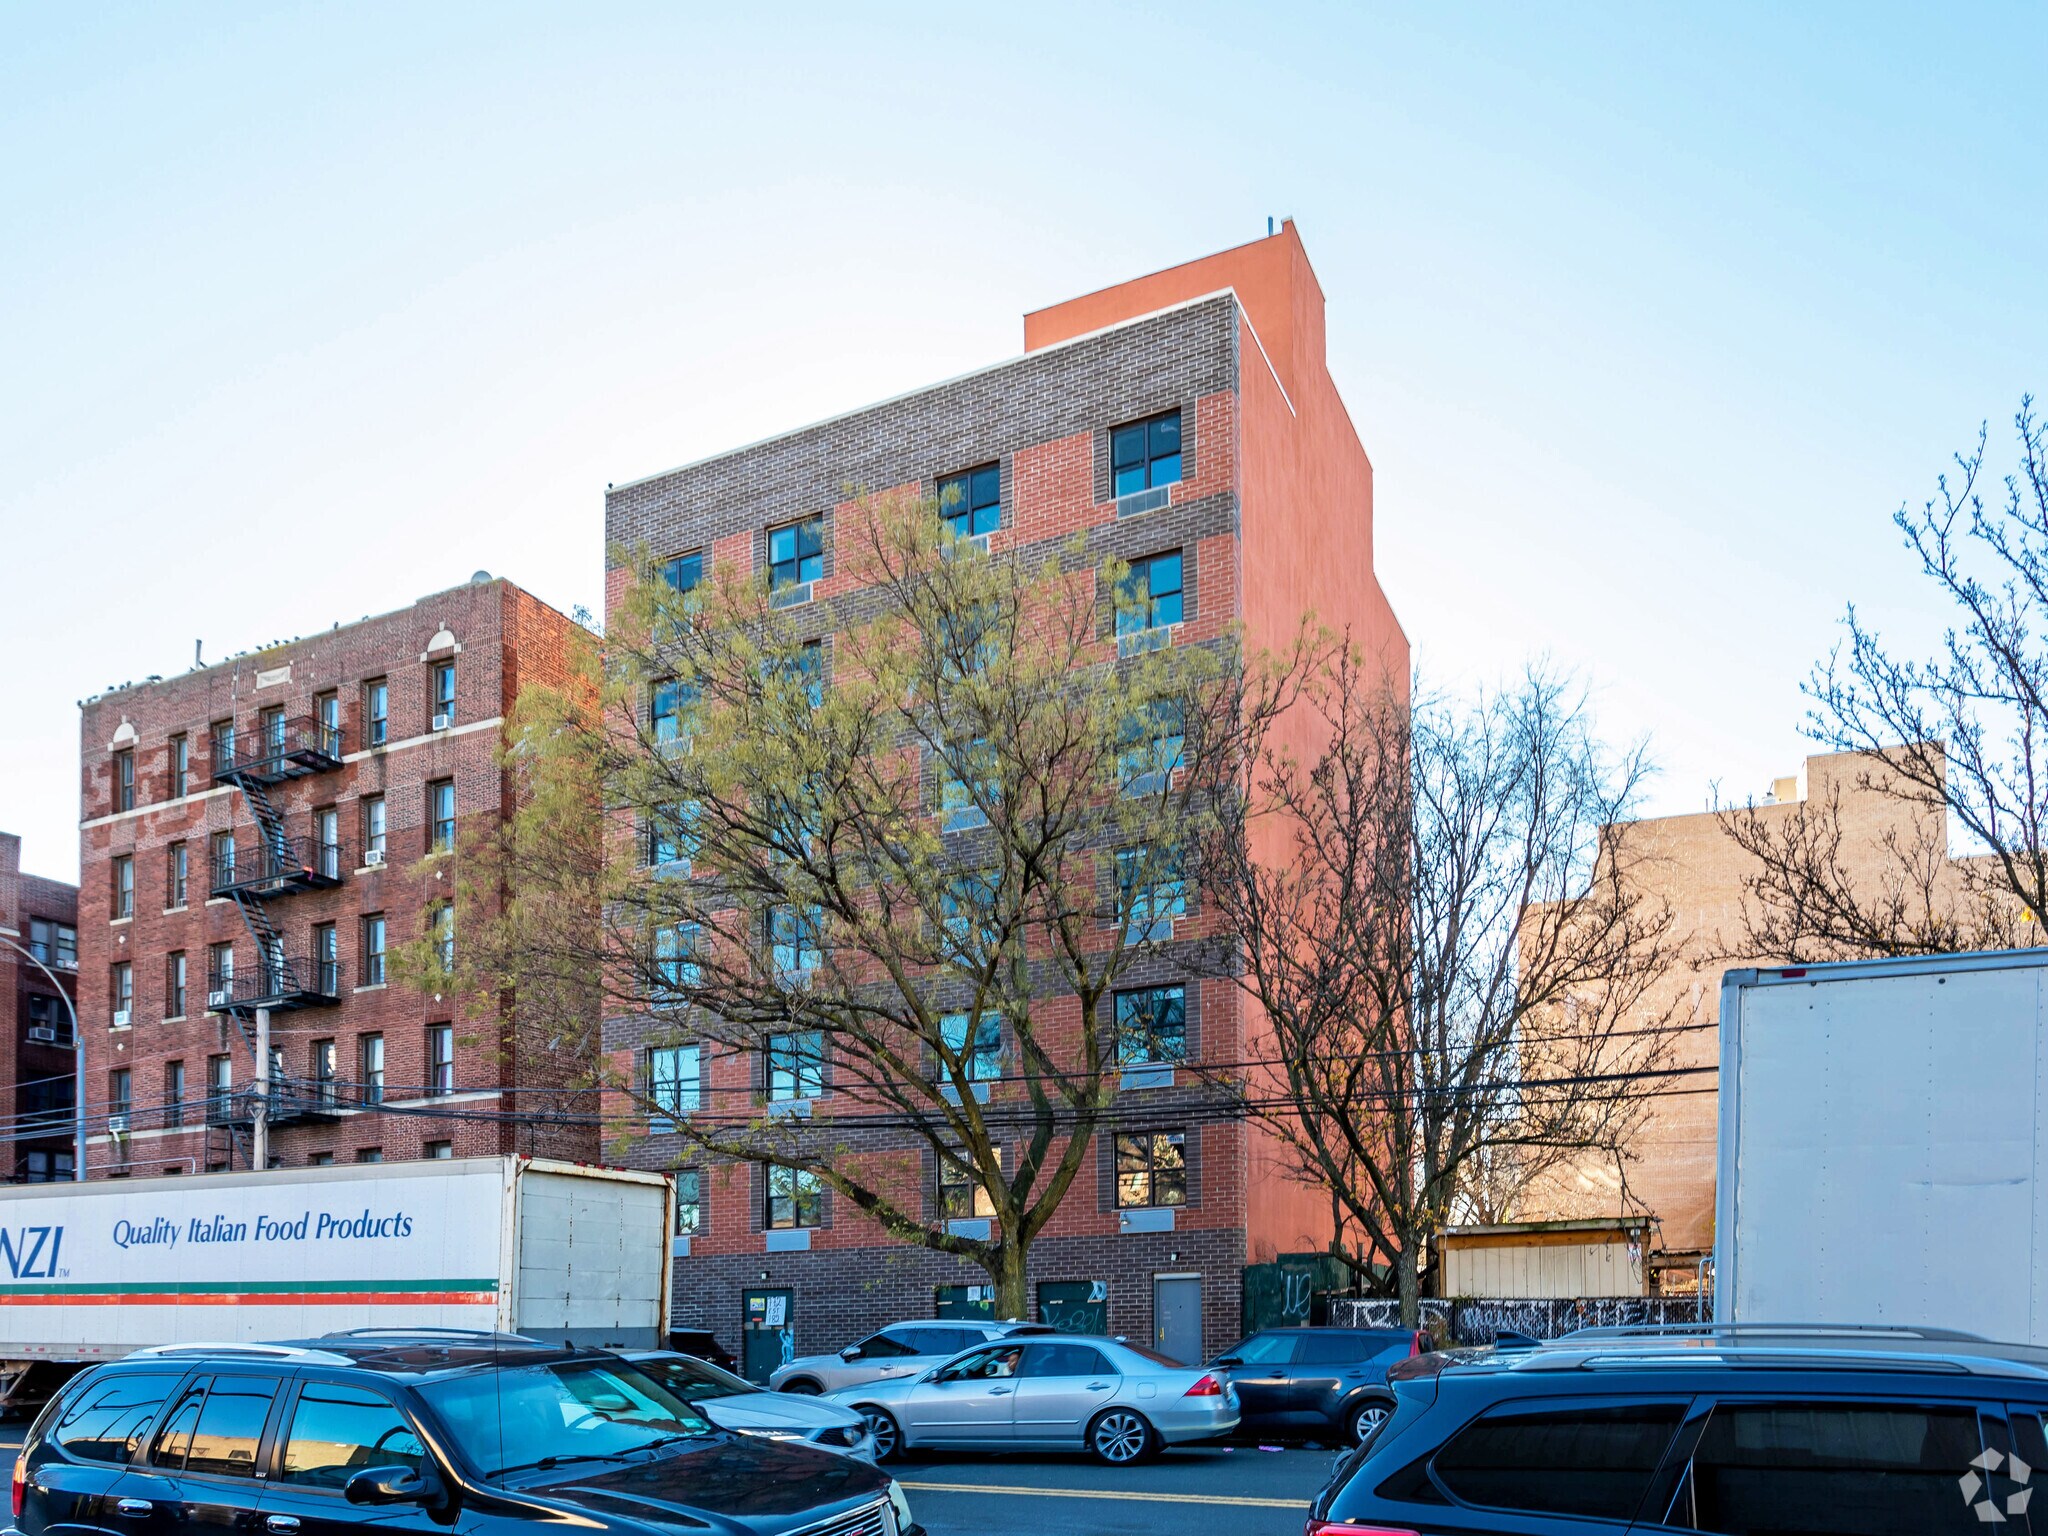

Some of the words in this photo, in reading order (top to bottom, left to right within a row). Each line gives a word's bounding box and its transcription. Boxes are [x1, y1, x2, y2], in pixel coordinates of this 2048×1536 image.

[0, 1226, 64, 1278] NZI
[112, 1216, 182, 1250] Quality
[187, 1214, 247, 1243] Italian
[254, 1211, 310, 1241] Food
[315, 1208, 413, 1240] Products
